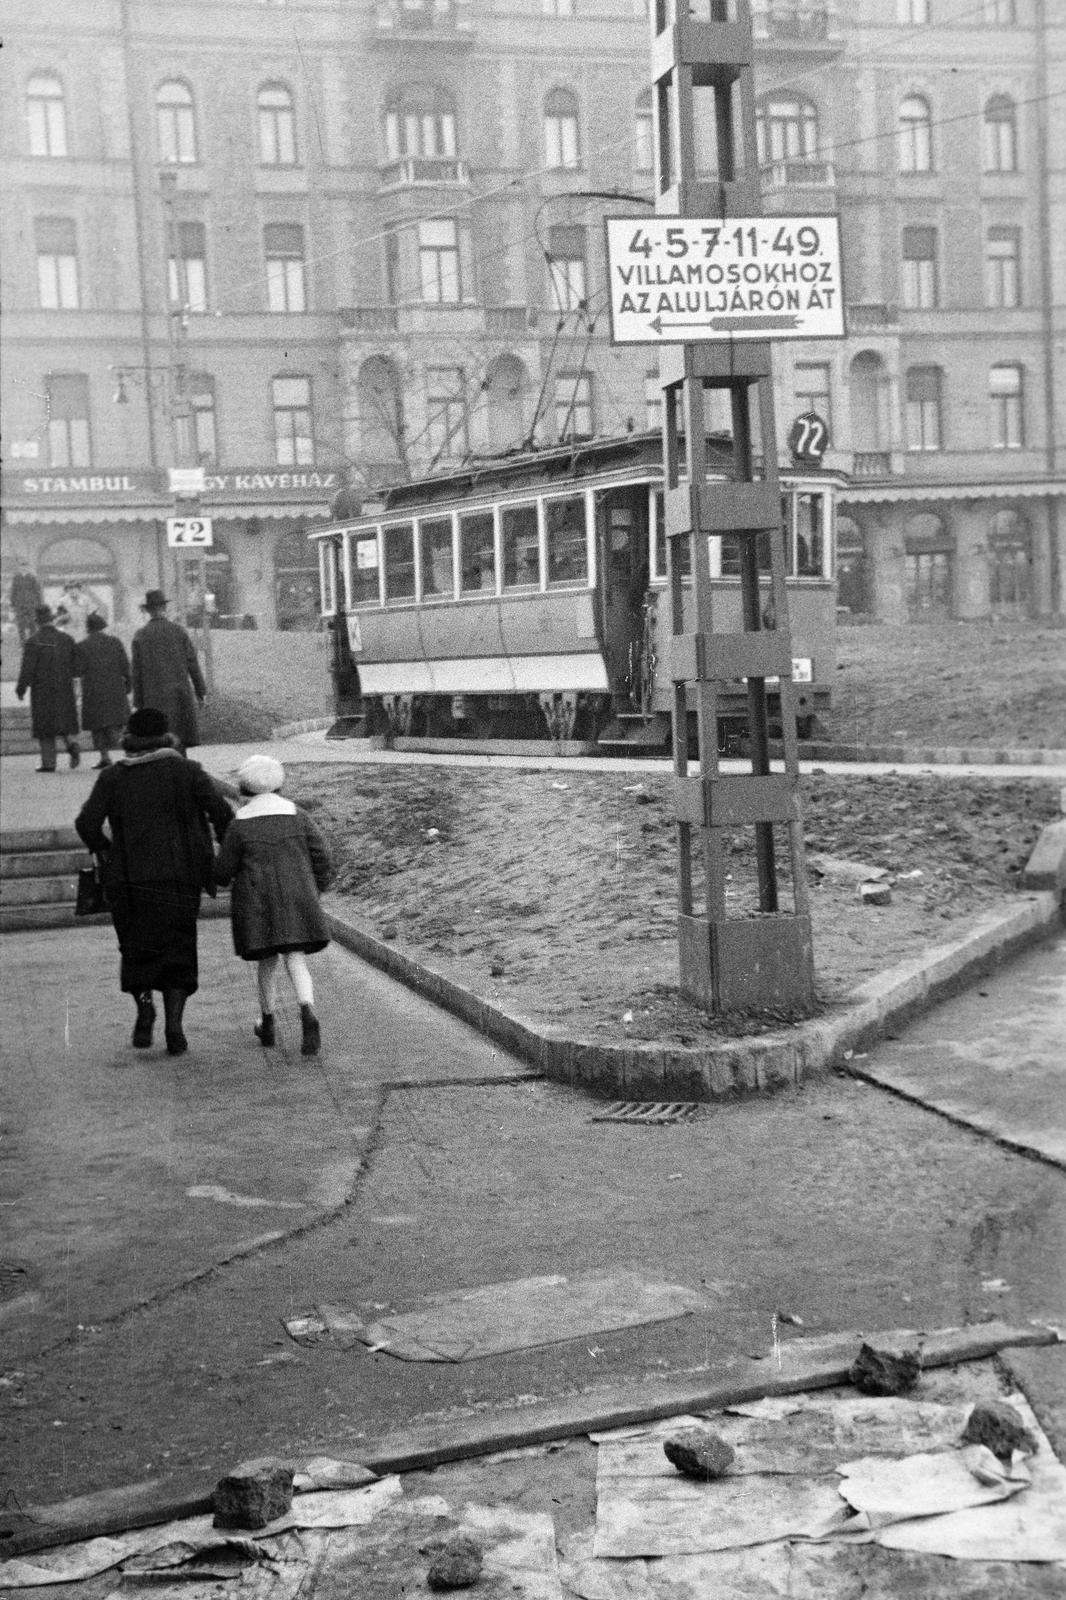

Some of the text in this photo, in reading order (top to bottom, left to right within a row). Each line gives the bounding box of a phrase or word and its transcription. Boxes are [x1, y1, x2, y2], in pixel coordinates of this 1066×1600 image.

[616, 262, 833, 285] VILLAMOSOKHOZ
[619, 283, 836, 314] AZ ALULJÁRÓN ÁT
[797, 418, 823, 456] 72
[23, 476, 137, 492] STAMBUL
[173, 521, 206, 543] 72
